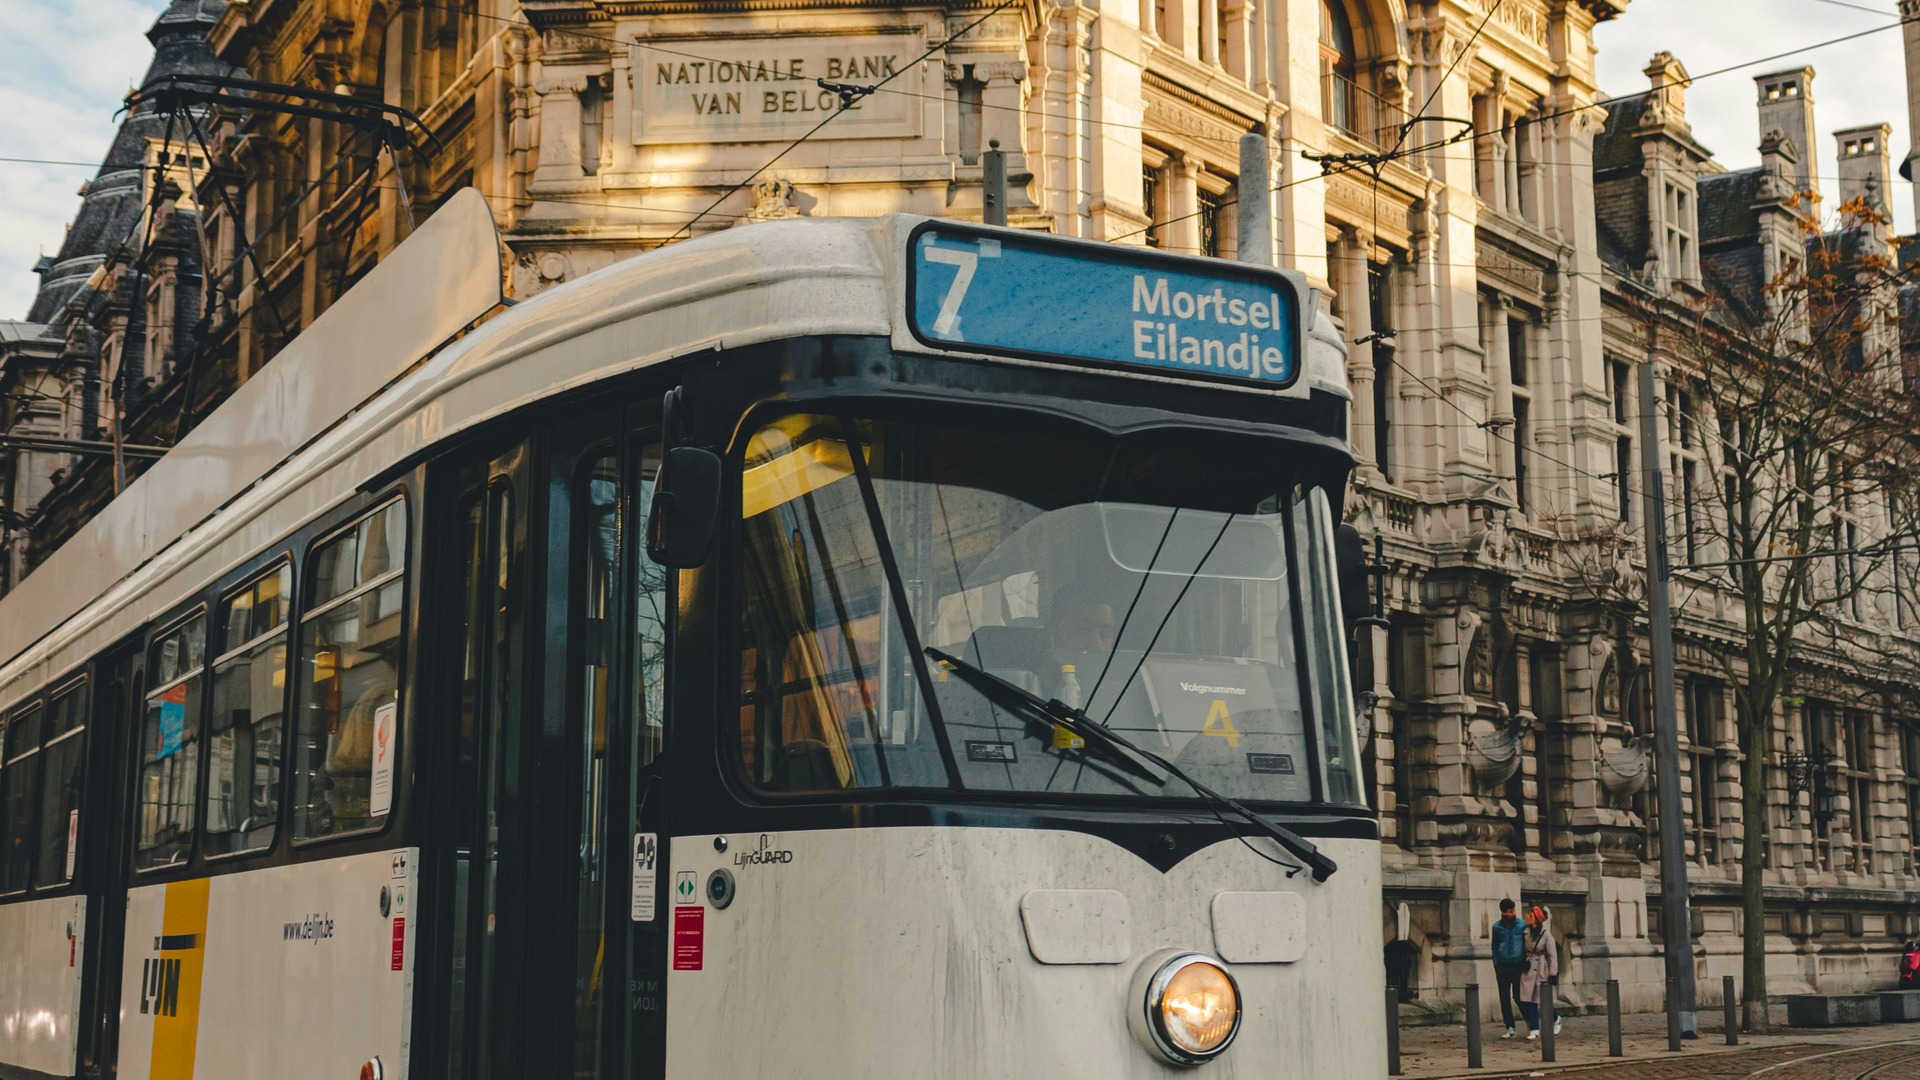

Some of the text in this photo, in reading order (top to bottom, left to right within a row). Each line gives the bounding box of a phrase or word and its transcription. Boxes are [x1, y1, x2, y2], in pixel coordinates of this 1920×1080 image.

[656, 54, 898, 85] NATIONALE BANK
[691, 91, 742, 115] VAN
[924, 245, 978, 335] 7
[1131, 274, 1281, 331] Mortsel
[1132, 319, 1285, 379] Eilandje
[1180, 682, 1247, 695] Volgnummer
[1203, 699, 1240, 748] 4
[733, 849, 793, 870] LijnGUARD
[283, 912, 334, 945] www.delijn.be
